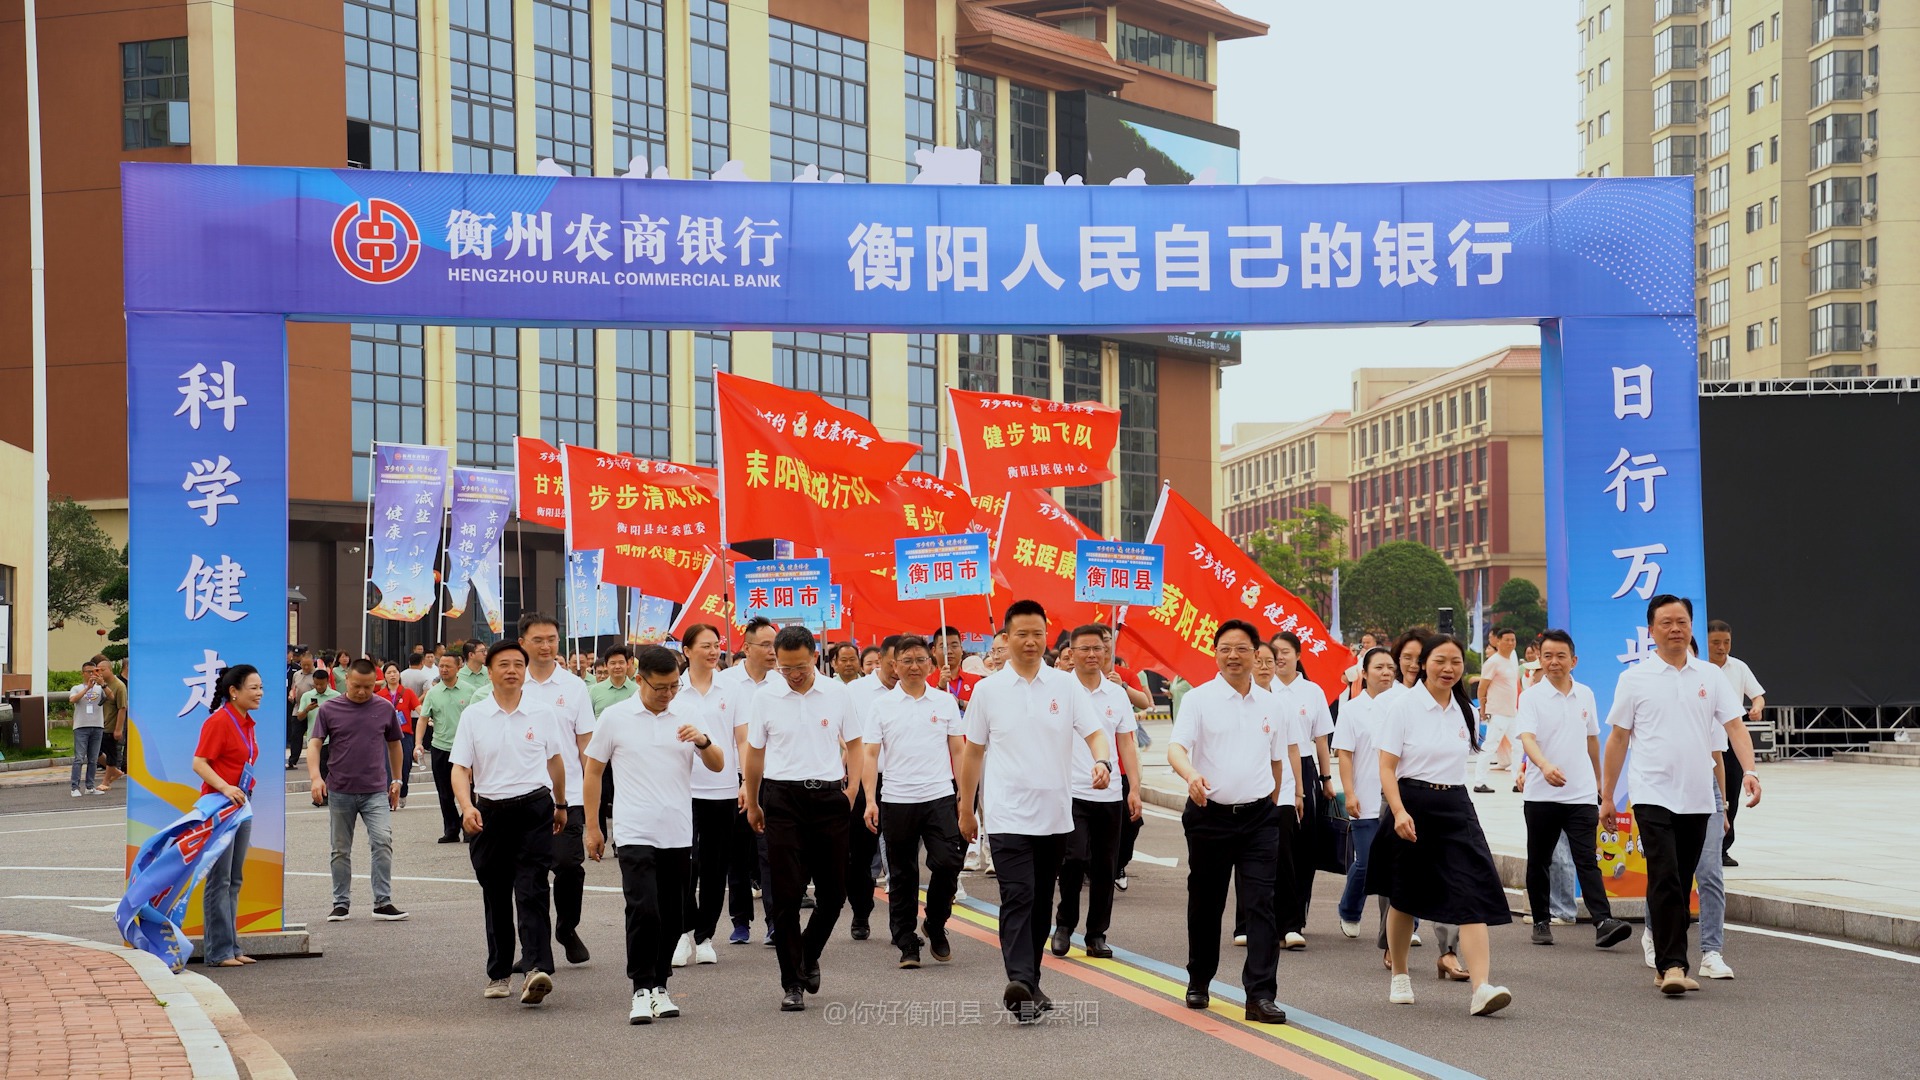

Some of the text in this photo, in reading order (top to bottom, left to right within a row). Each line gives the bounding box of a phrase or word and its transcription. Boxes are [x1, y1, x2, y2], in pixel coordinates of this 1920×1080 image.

[445, 208, 783, 267] 衡州农商银行
[847, 220, 1513, 292] 衡阳人民自己的银行
[448, 268, 781, 288] HENGZHOU RURAL COMMERCIAL BANK
[982, 421, 1093, 450] 健步如飞队
[1007, 462, 1088, 479] 衡阳县医保中心
[588, 483, 711, 511] 步步清风队
[173, 360, 248, 718] 科学健走
[616, 521, 706, 537] 衡阳县纪委监委
[384, 505, 405, 594] 健康一大步
[907, 558, 979, 585] 衡阳市
[1086, 565, 1153, 591] 衡阳县
[1188, 542, 1237, 590] 万步有约
[748, 584, 820, 609] 耒阳市
[1147, 582, 1218, 658] 蒸阳控
[1262, 602, 1329, 658] 健康体重
